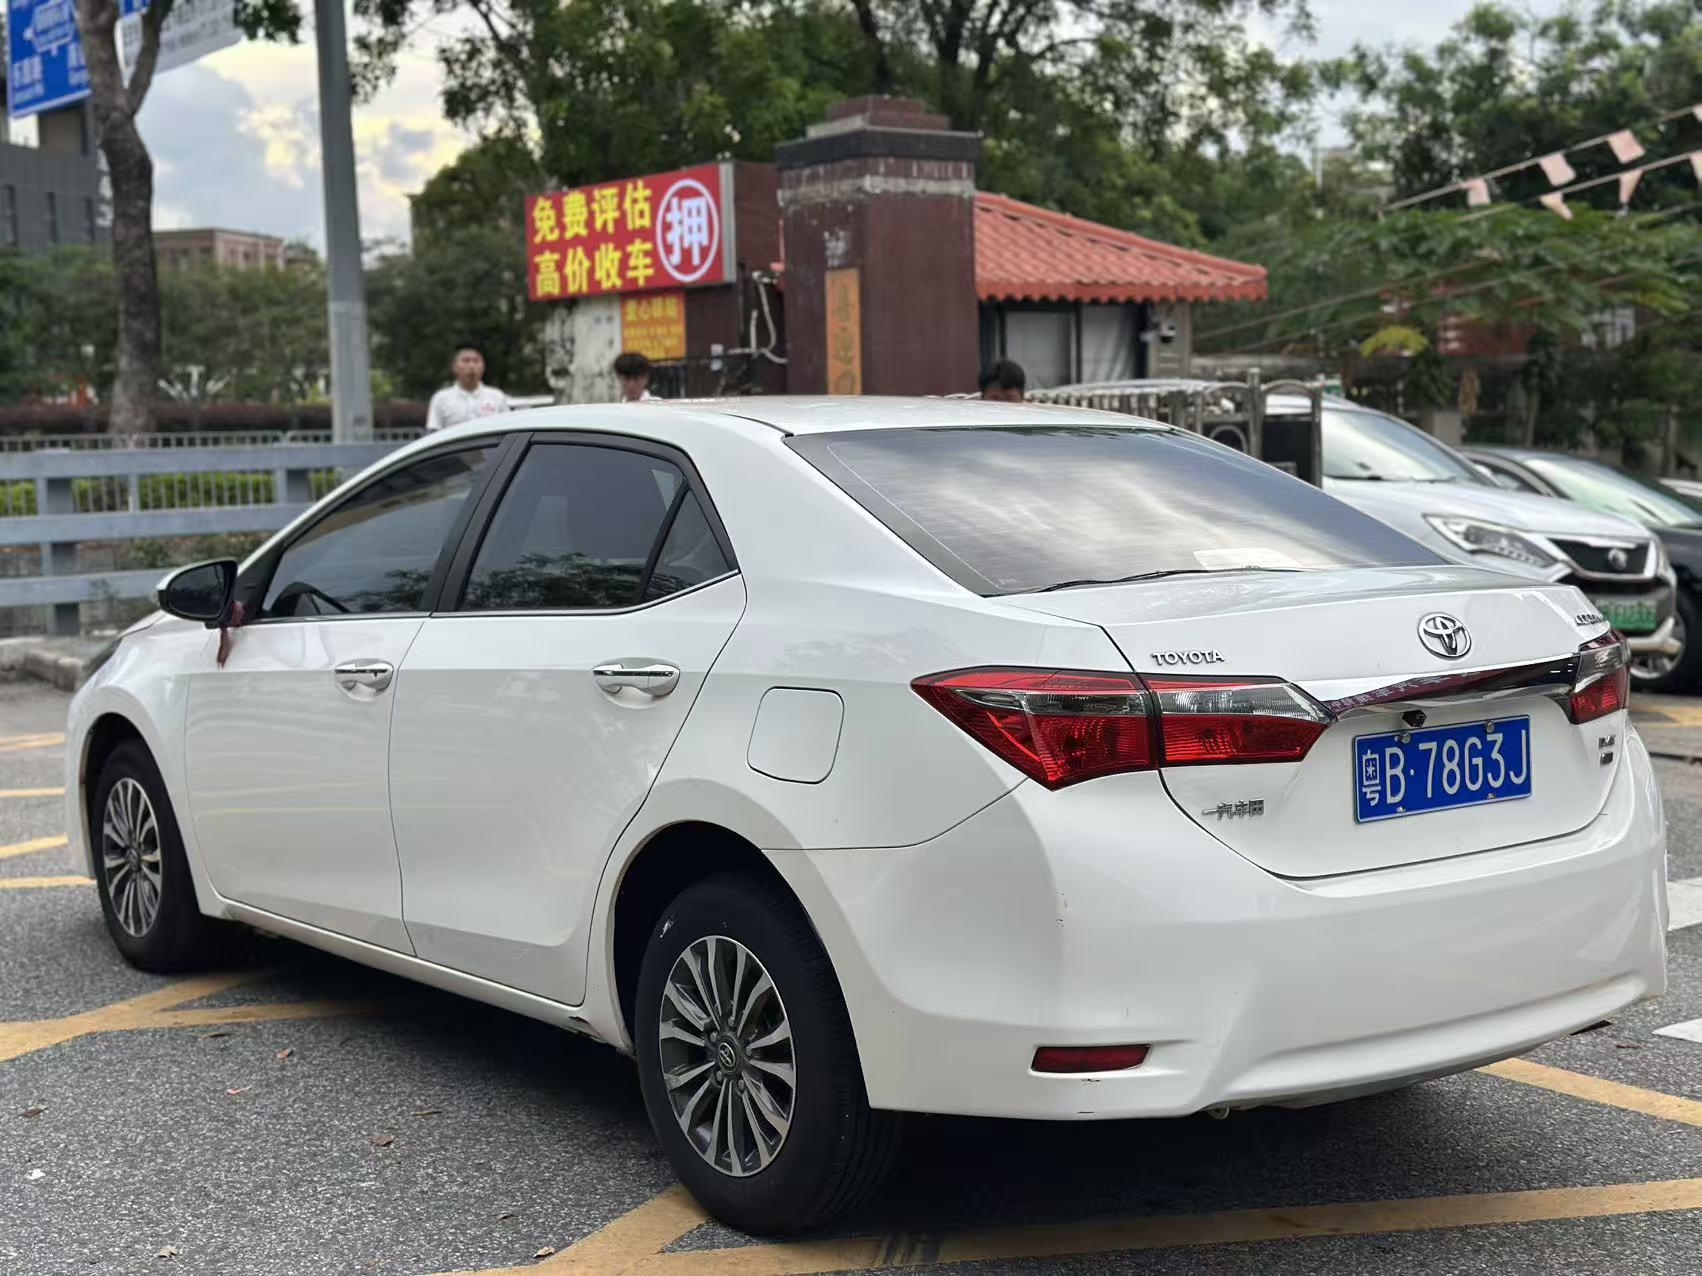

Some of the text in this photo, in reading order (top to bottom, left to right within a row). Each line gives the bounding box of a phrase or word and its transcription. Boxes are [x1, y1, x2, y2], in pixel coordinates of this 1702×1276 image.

[533, 180, 652, 244] 免费评估
[666, 196, 709, 266] 押
[534, 238, 654, 297] 高价收车
[1151, 649, 1225, 666] TOYOTA
[1362, 729, 1527, 806] 粤B·78G3J
